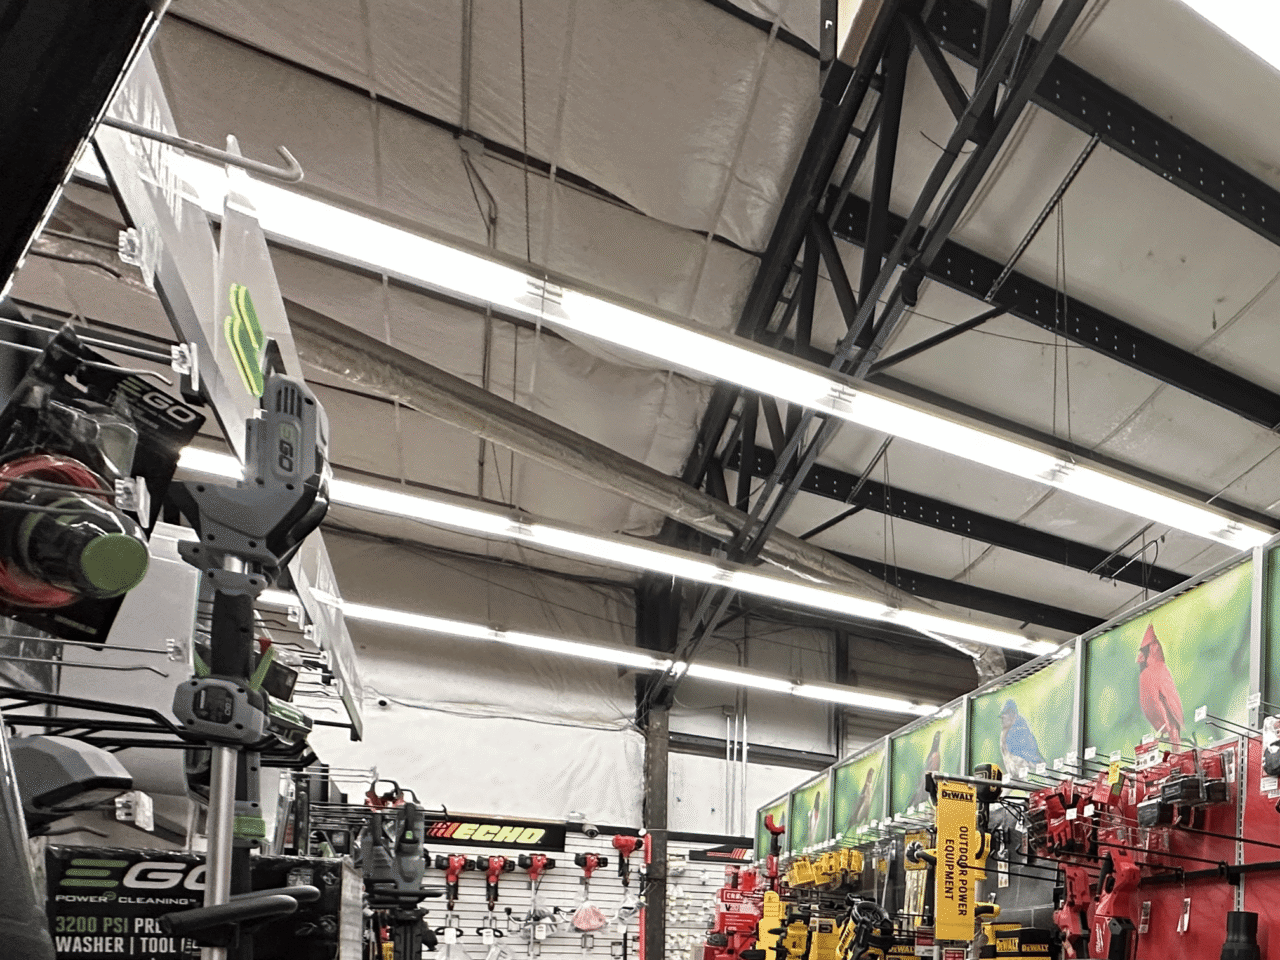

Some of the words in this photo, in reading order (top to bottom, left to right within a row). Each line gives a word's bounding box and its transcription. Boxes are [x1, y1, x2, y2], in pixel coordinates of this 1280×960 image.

[452, 821, 546, 845] ECHO
[944, 838, 956, 901] EQUIPMENT
[958, 877, 968, 917] POWER
[55, 916, 97, 933] 3200
[103, 917, 128, 933] PSI
[56, 936, 125, 953] WASHER
[140, 937, 177, 953] TOOL
